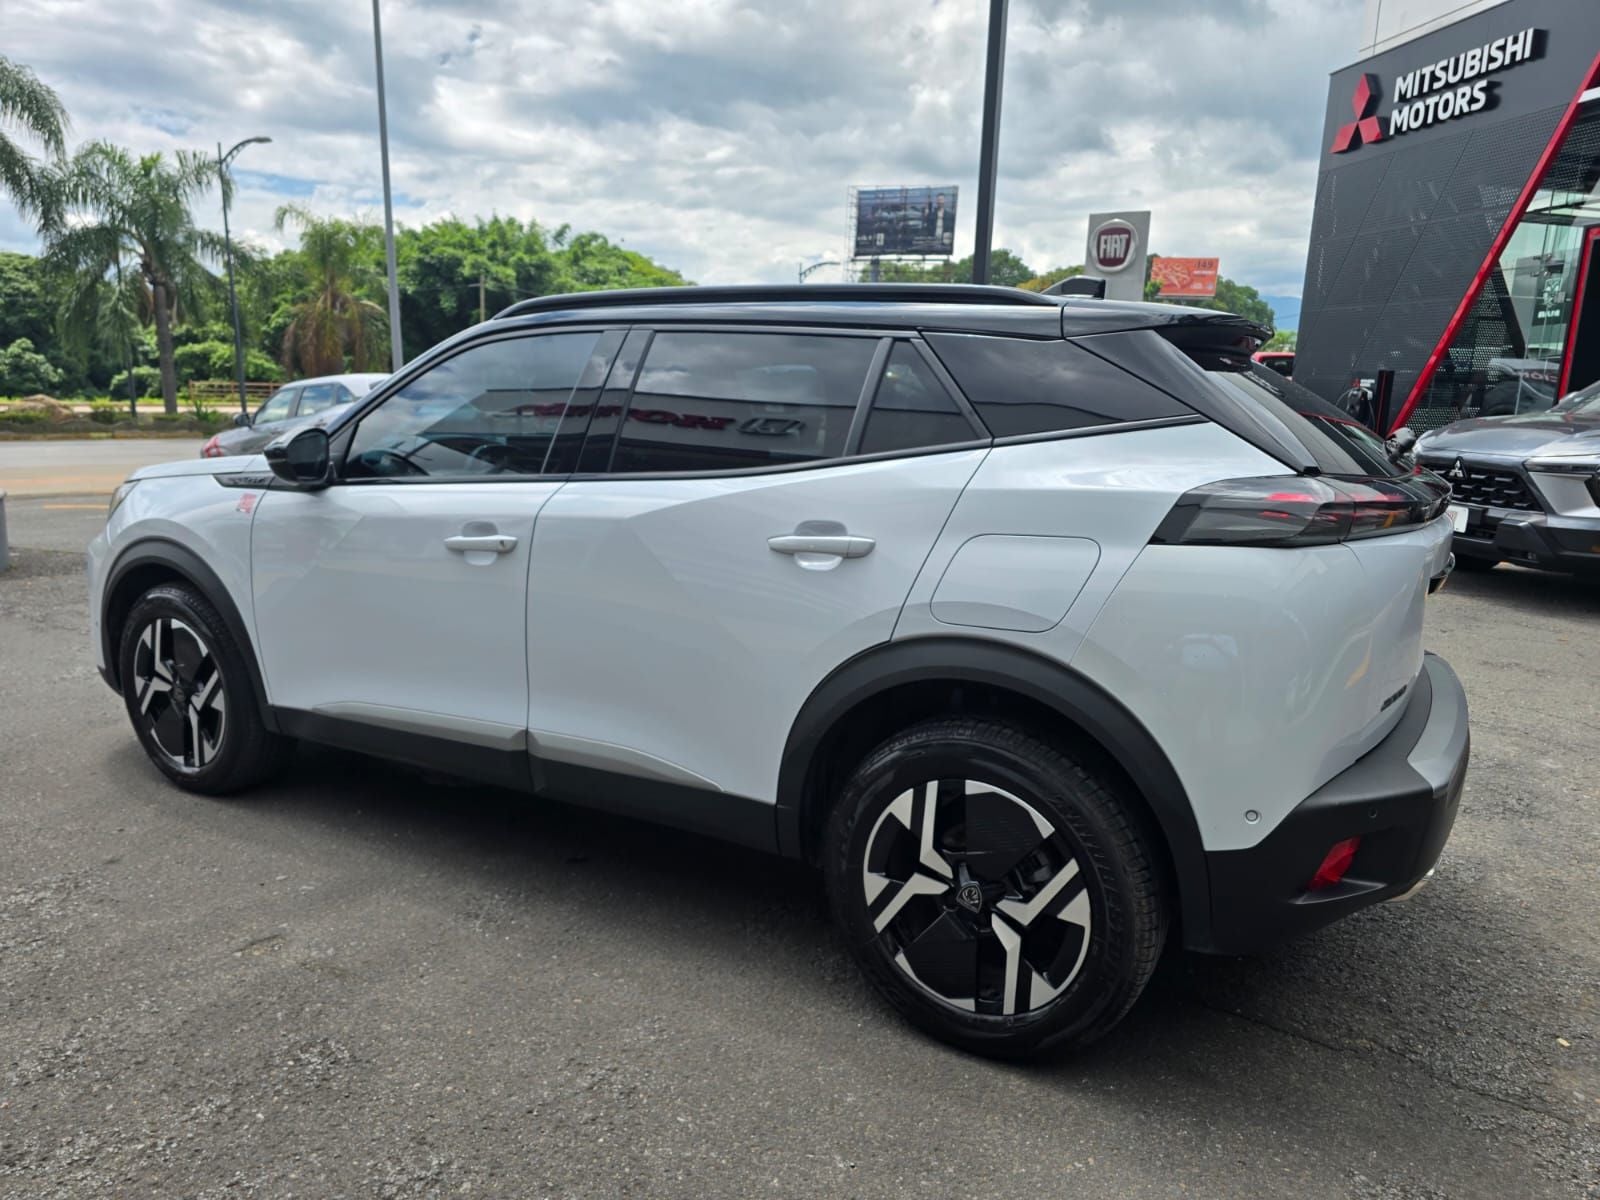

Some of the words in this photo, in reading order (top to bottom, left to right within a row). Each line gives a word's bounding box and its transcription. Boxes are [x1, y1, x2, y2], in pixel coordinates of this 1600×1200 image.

[1393, 28, 1535, 103] MITSUBISHI
[1389, 80, 1488, 135] MOTORS
[1100, 234, 1129, 258] FIAT
